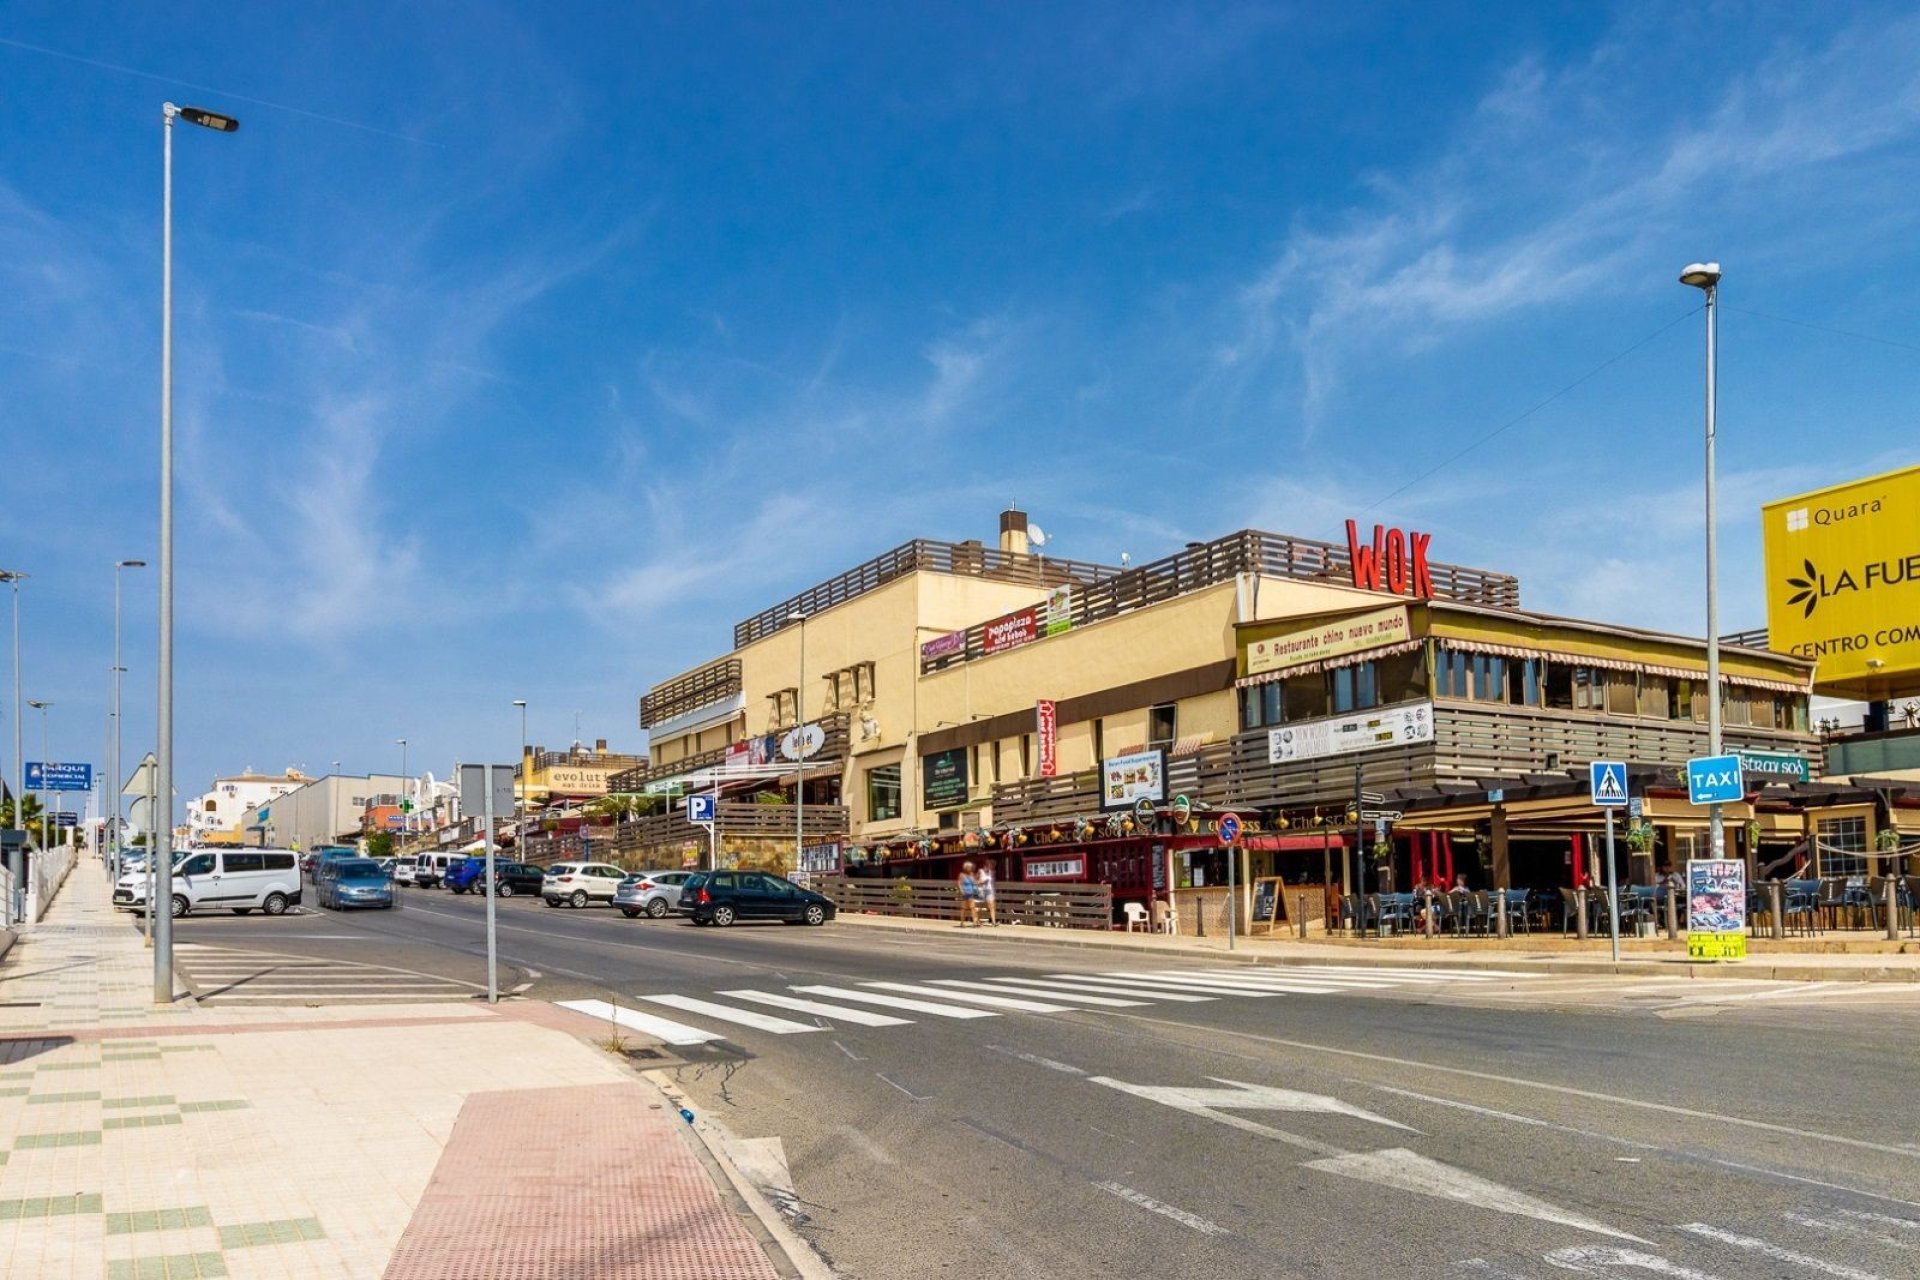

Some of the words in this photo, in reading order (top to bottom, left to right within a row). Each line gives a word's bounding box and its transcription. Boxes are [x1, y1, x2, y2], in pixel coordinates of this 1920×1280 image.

[1814, 500, 1882, 525] Quara
[1345, 519, 1434, 599] WOK
[1819, 569, 1859, 597] LA
[1274, 635, 1319, 656] Restaurante
[1323, 630, 1344, 644] chino
[1349, 624, 1373, 639] nuevo
[1378, 614, 1404, 632] mundo
[1692, 770, 1739, 788] TAXI
